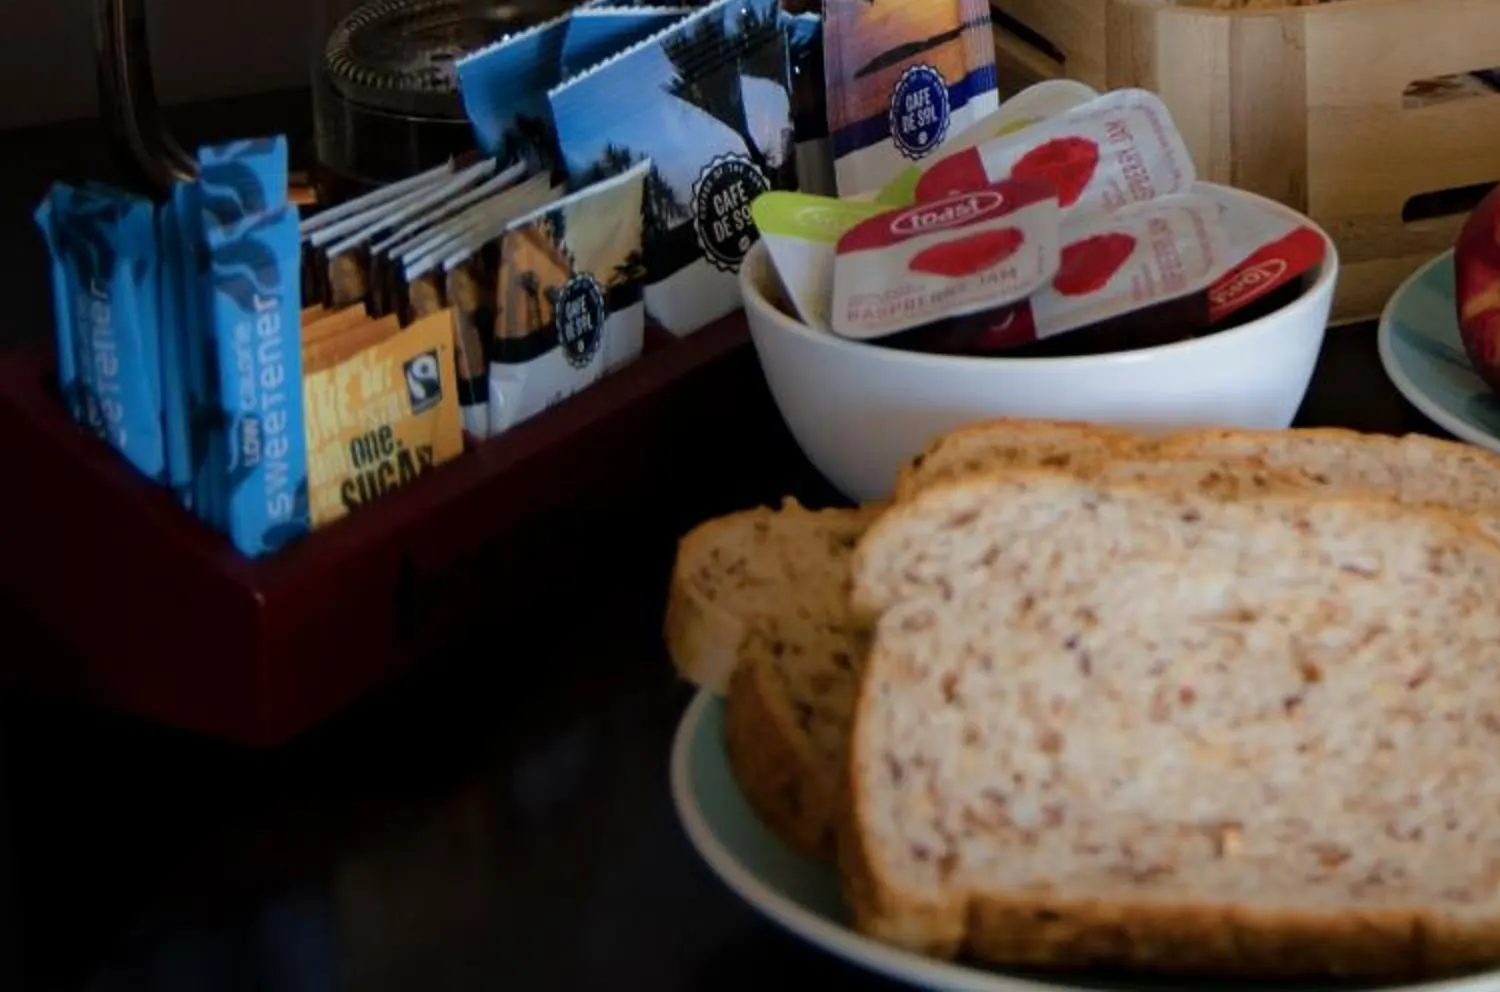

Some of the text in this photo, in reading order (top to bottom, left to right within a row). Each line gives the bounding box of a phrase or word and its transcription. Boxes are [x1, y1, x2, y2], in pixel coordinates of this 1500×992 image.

[712, 180, 749, 216] CAFE
[712, 214, 734, 244] DE
[349, 424, 393, 470] one
